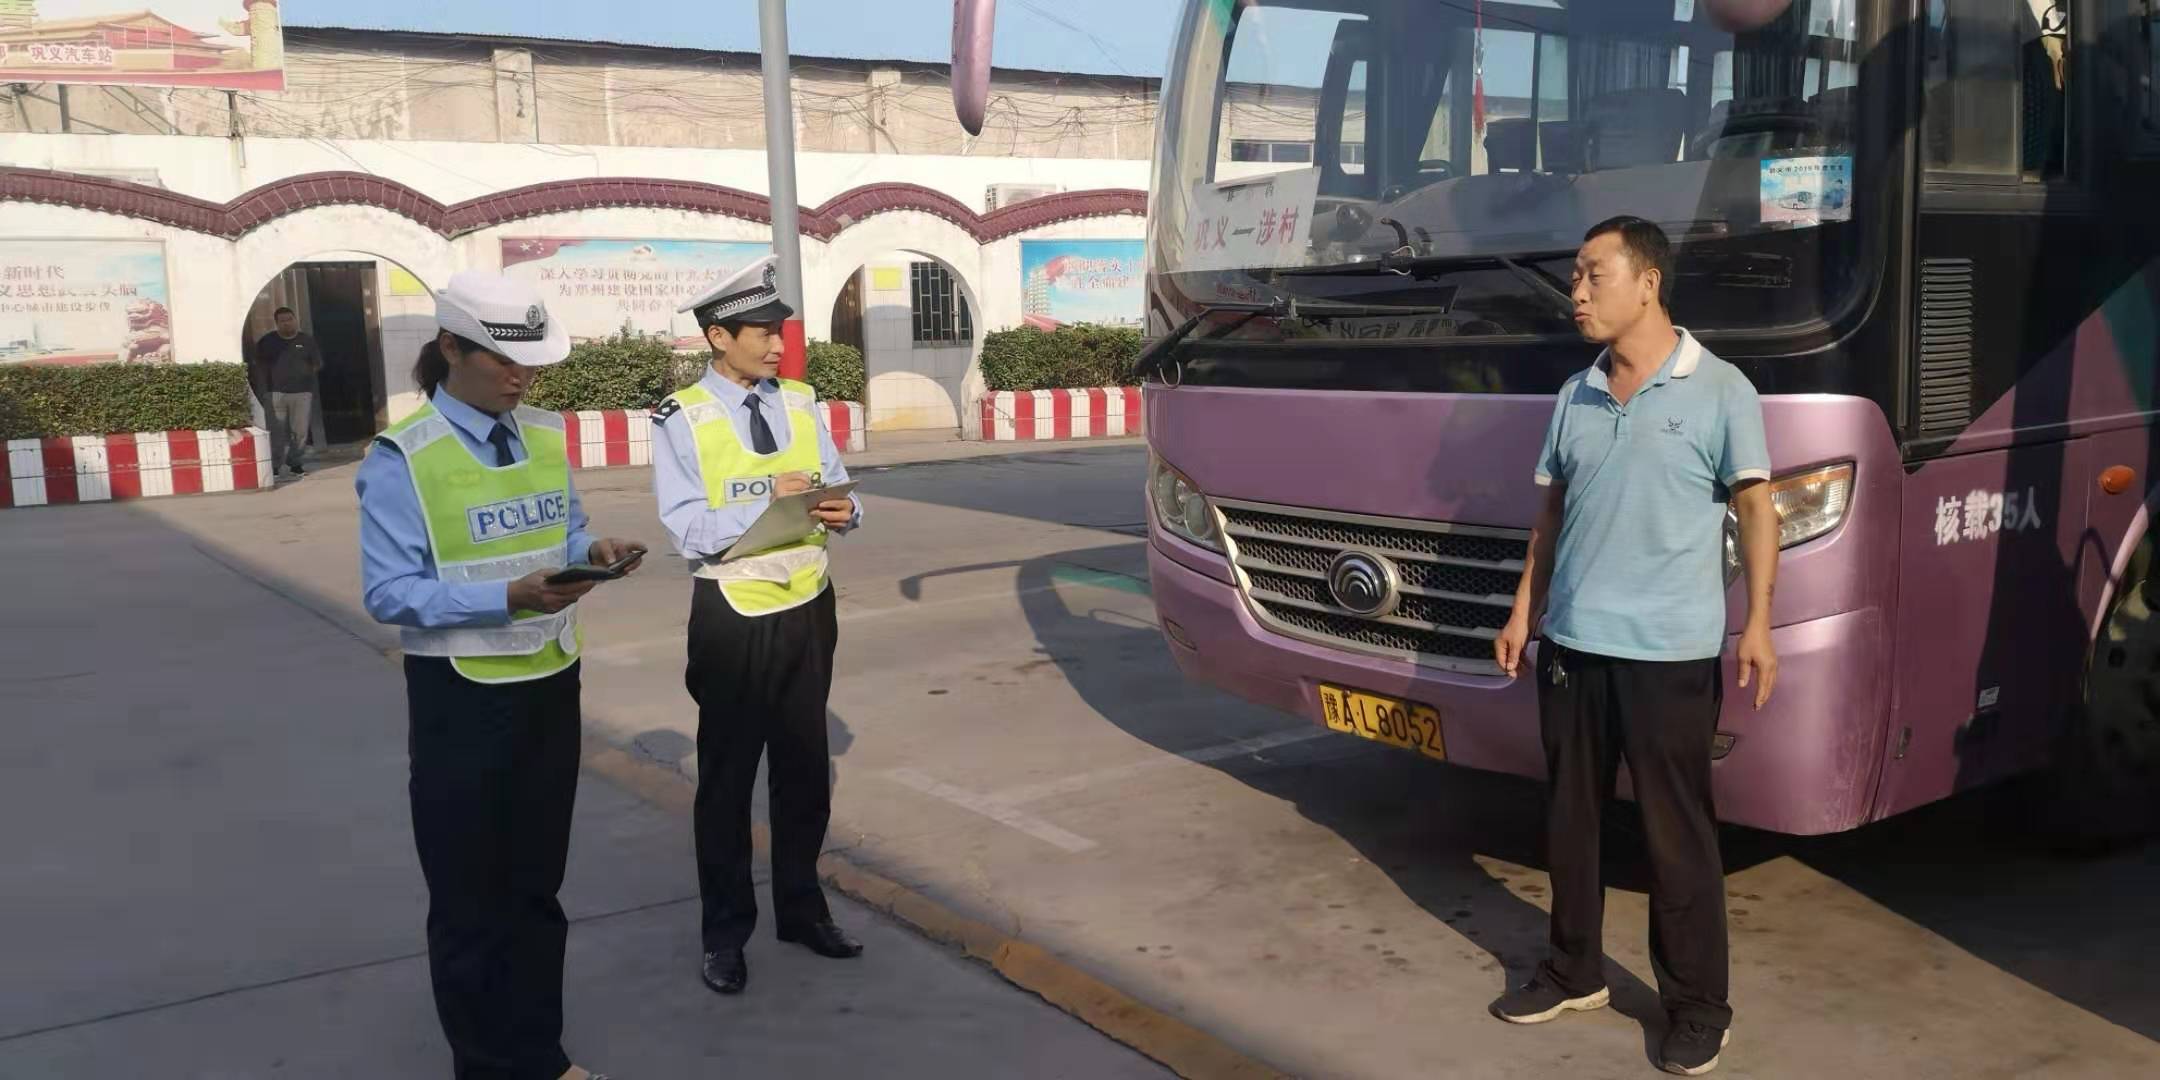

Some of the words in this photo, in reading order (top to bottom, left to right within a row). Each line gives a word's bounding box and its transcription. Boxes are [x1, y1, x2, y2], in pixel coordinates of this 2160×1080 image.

[31, 47, 112, 62] 巩义汽车站
[477, 495, 566, 535] POLICE
[1934, 485, 2041, 546] 核载35人
